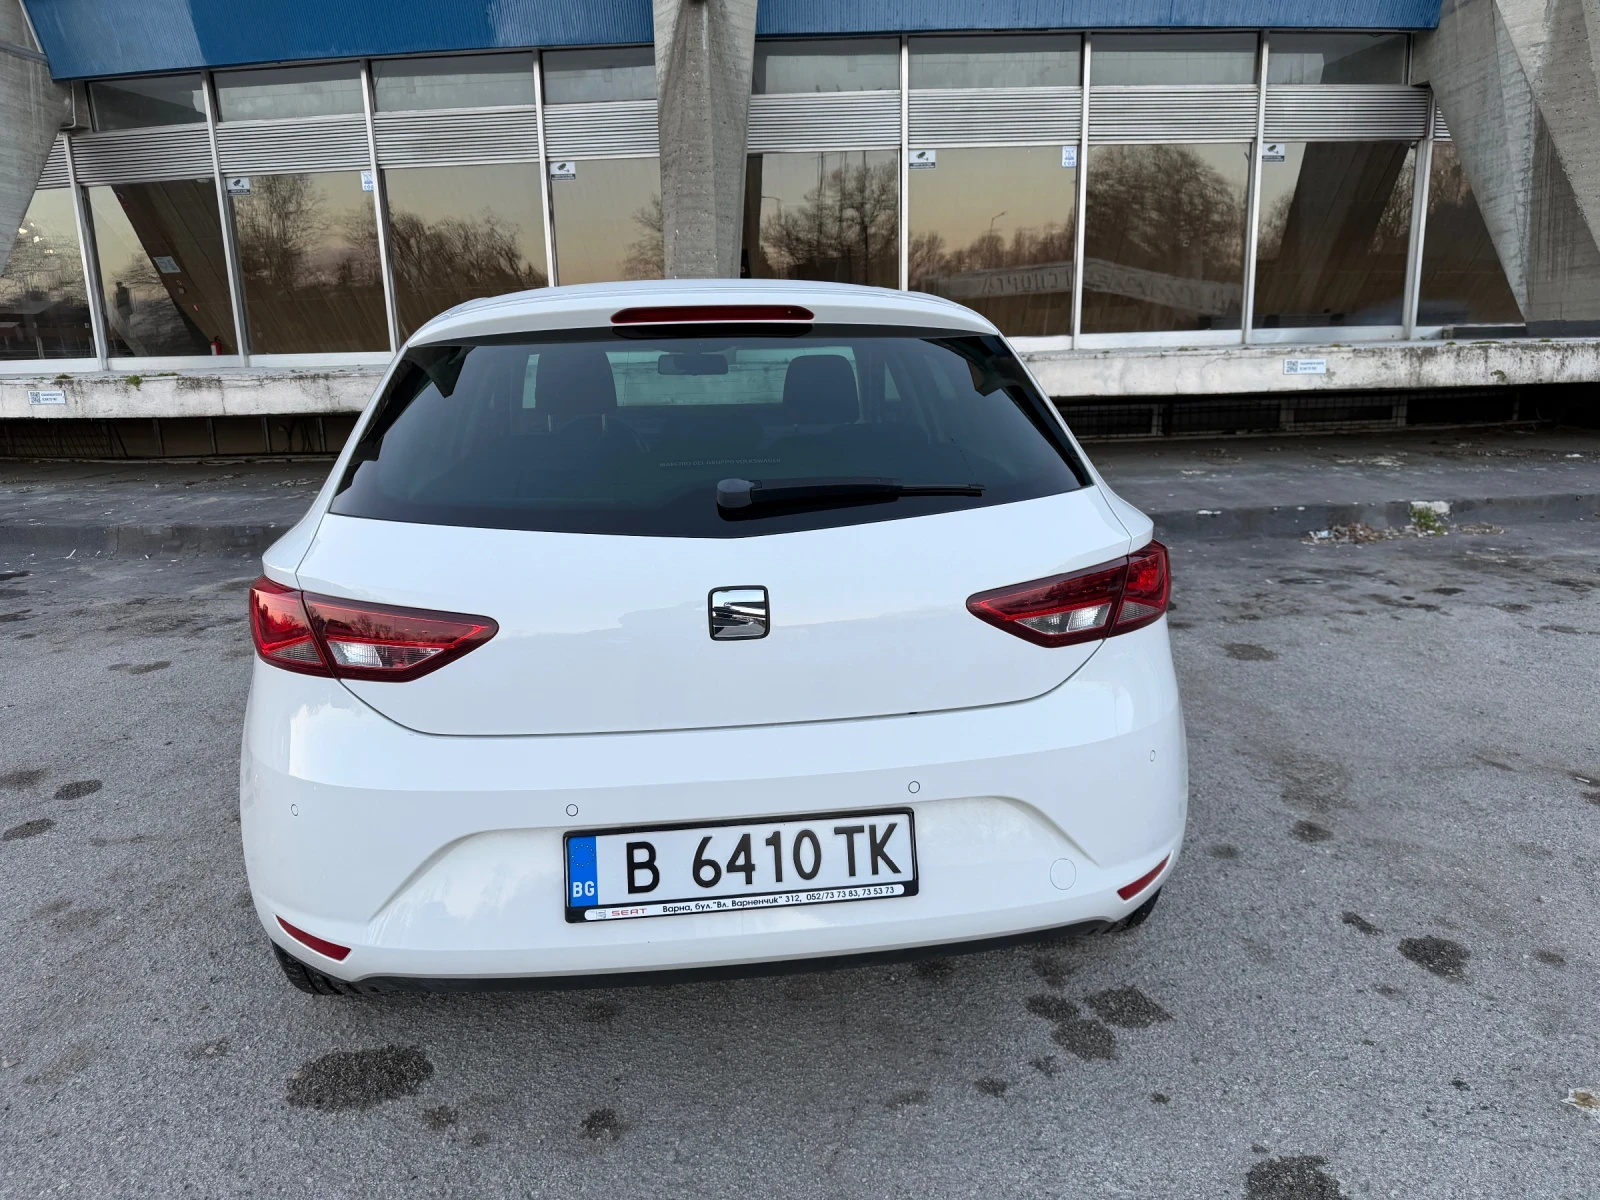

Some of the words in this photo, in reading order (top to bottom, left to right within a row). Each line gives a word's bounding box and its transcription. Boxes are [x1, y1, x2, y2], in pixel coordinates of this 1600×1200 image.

[626, 841, 660, 894] B
[692, 829, 822, 888] 6410
[834, 823, 902, 877] TK
[572, 880, 595, 898] BG
[662, 904, 693, 914] Варна,
[785, 894, 802, 903] 312,
[806, 890, 835, 901] 052/73
[836, 889, 847, 898] 73
[862, 887, 872, 896] 73
[873, 886, 884, 895] 53
[885, 886, 895, 894] 73
[611, 907, 648, 916] SEAT
